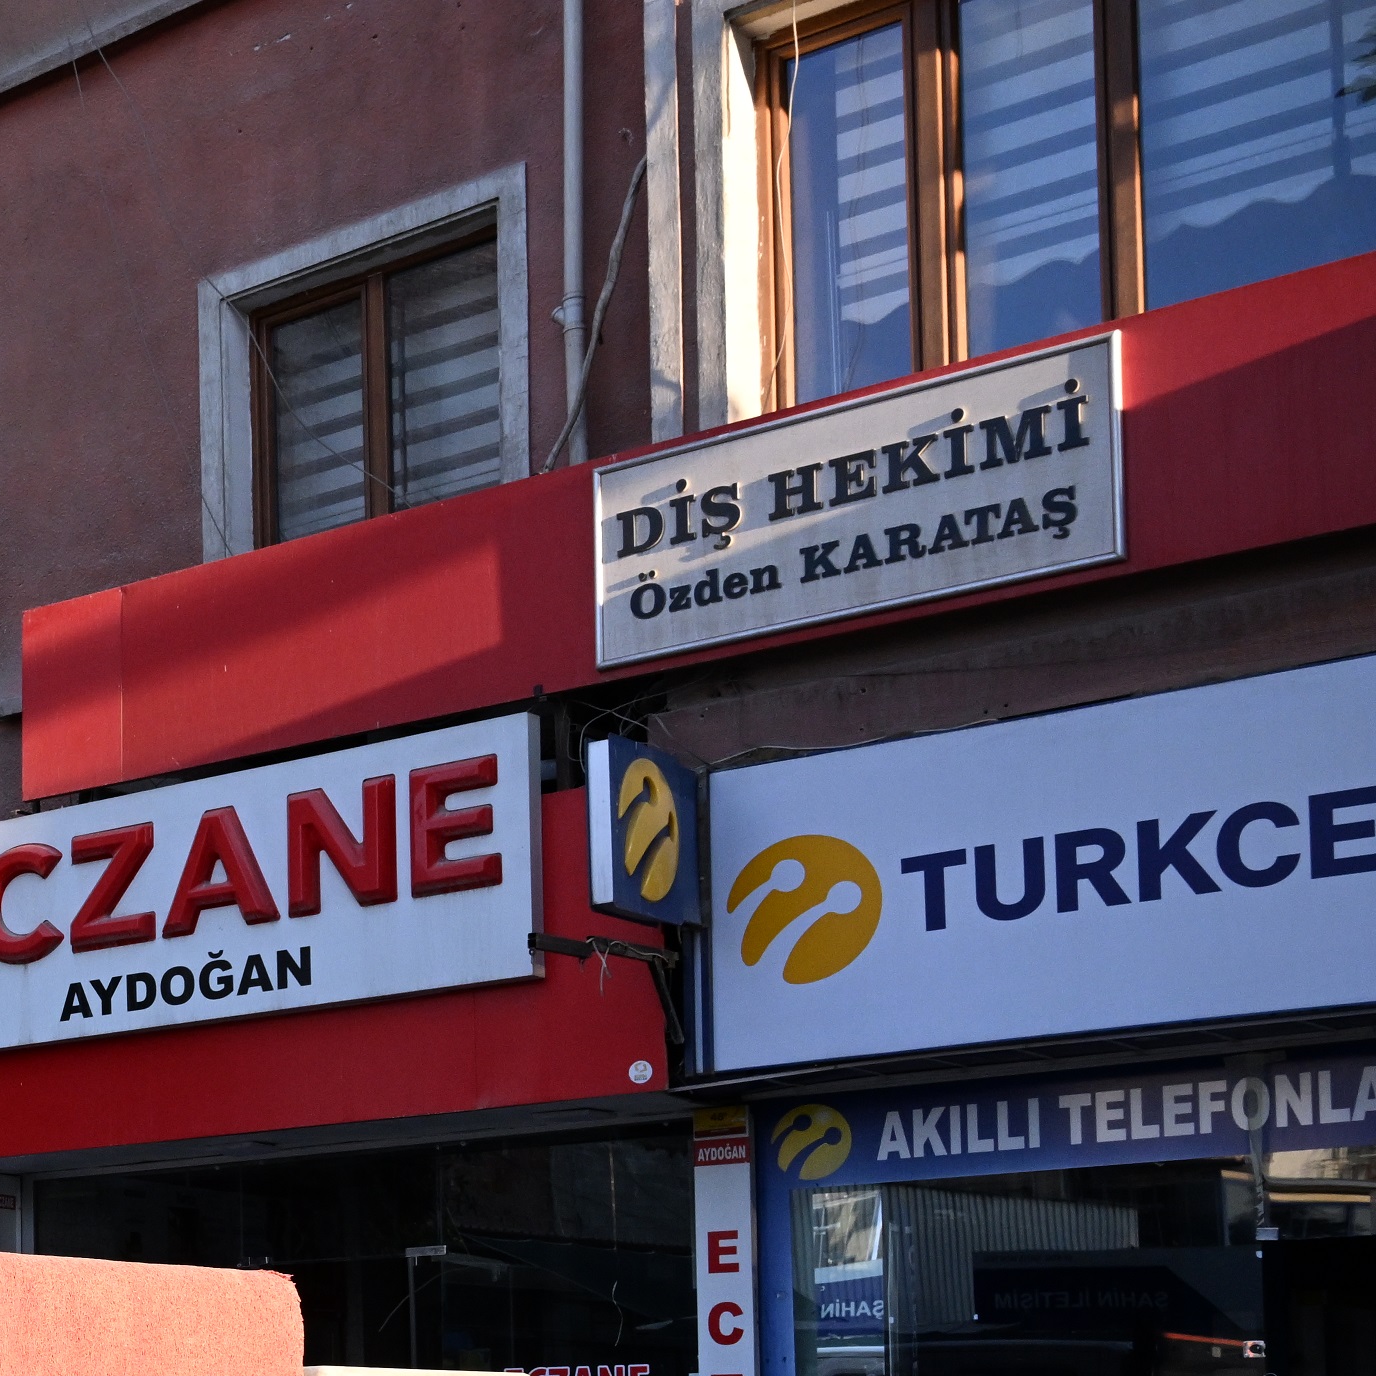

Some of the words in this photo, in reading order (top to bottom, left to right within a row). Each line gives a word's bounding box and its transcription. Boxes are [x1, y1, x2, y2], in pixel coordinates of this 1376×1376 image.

[616, 477, 742, 550] DİŞ
[768, 377, 1090, 522] HEKİMİ
[630, 570, 782, 621] Özden
[799, 484, 1079, 585] KARATAŞ
[900, 784, 1376, 933] TURKCE
[59, 945, 313, 1022] AYDOĞAN
[697, 1143, 746, 1162] AYDOĞAN
[877, 1097, 1041, 1162] AKILLI
